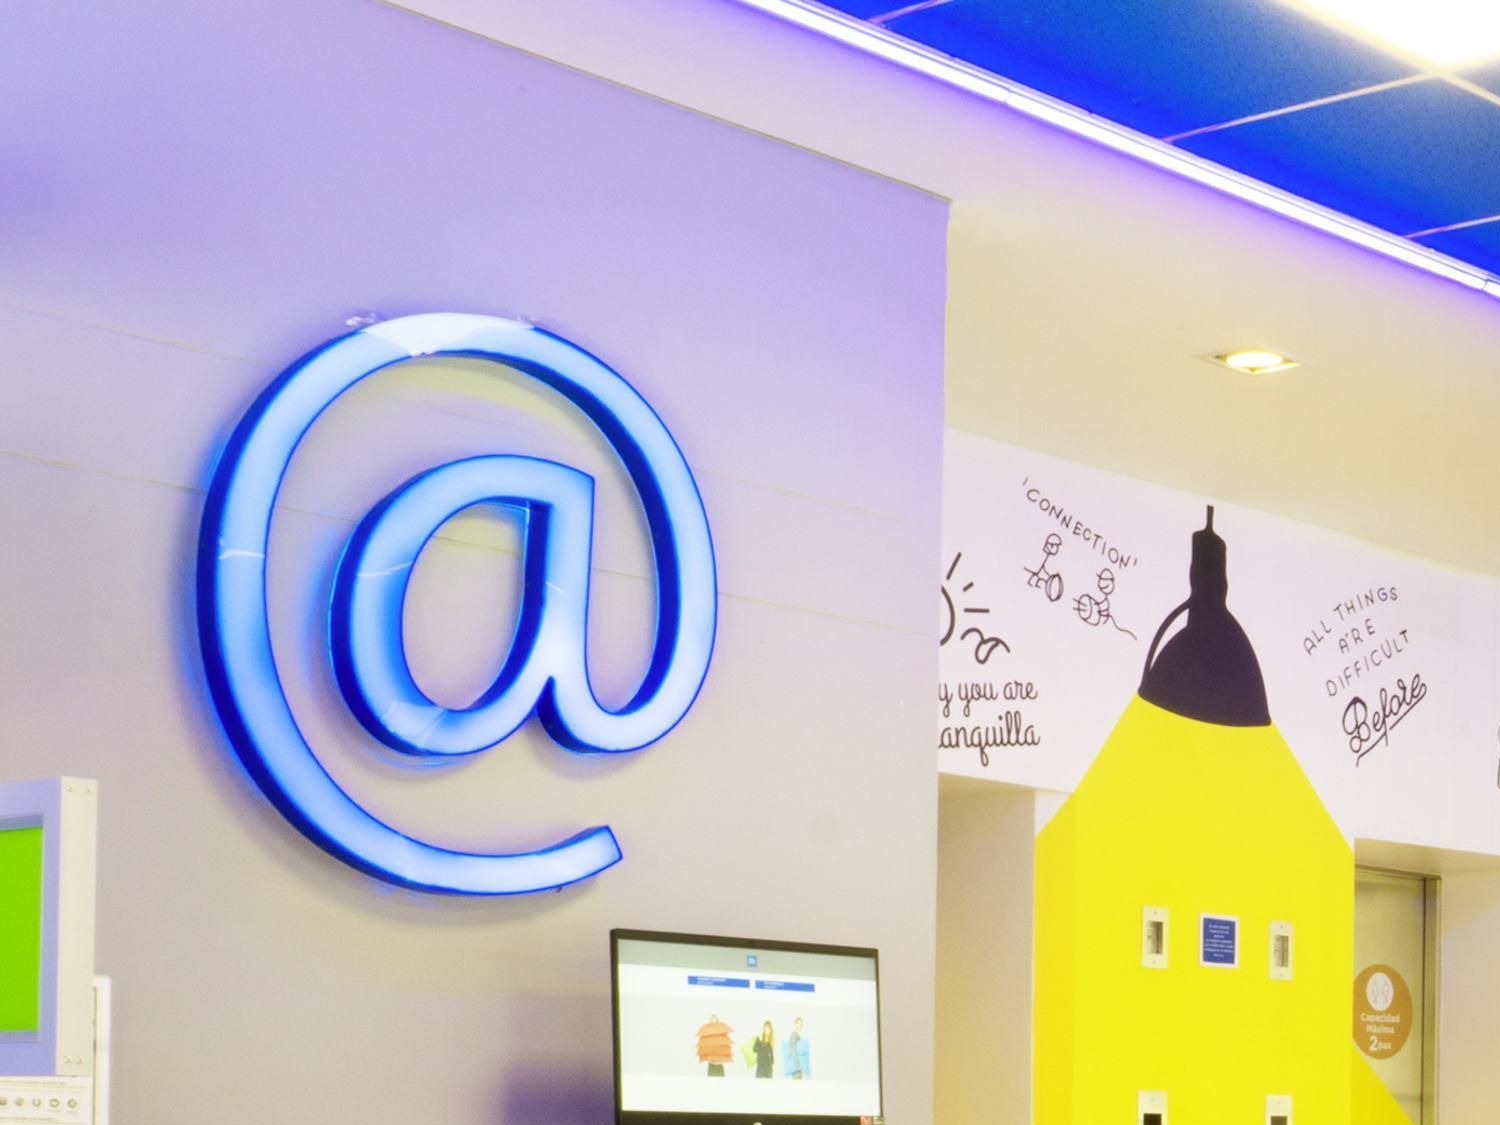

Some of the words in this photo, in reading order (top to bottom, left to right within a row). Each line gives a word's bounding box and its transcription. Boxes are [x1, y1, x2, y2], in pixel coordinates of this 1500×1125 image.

[1303, 620, 1332, 656] ALL
[1333, 586, 1399, 621] THINGS
[1338, 618, 1376, 654] ARE
[1325, 629, 1409, 697] DIFFICULT
[958, 682, 999, 718] you
[1002, 680, 1038, 701] are
[1342, 673, 1427, 764] Before
